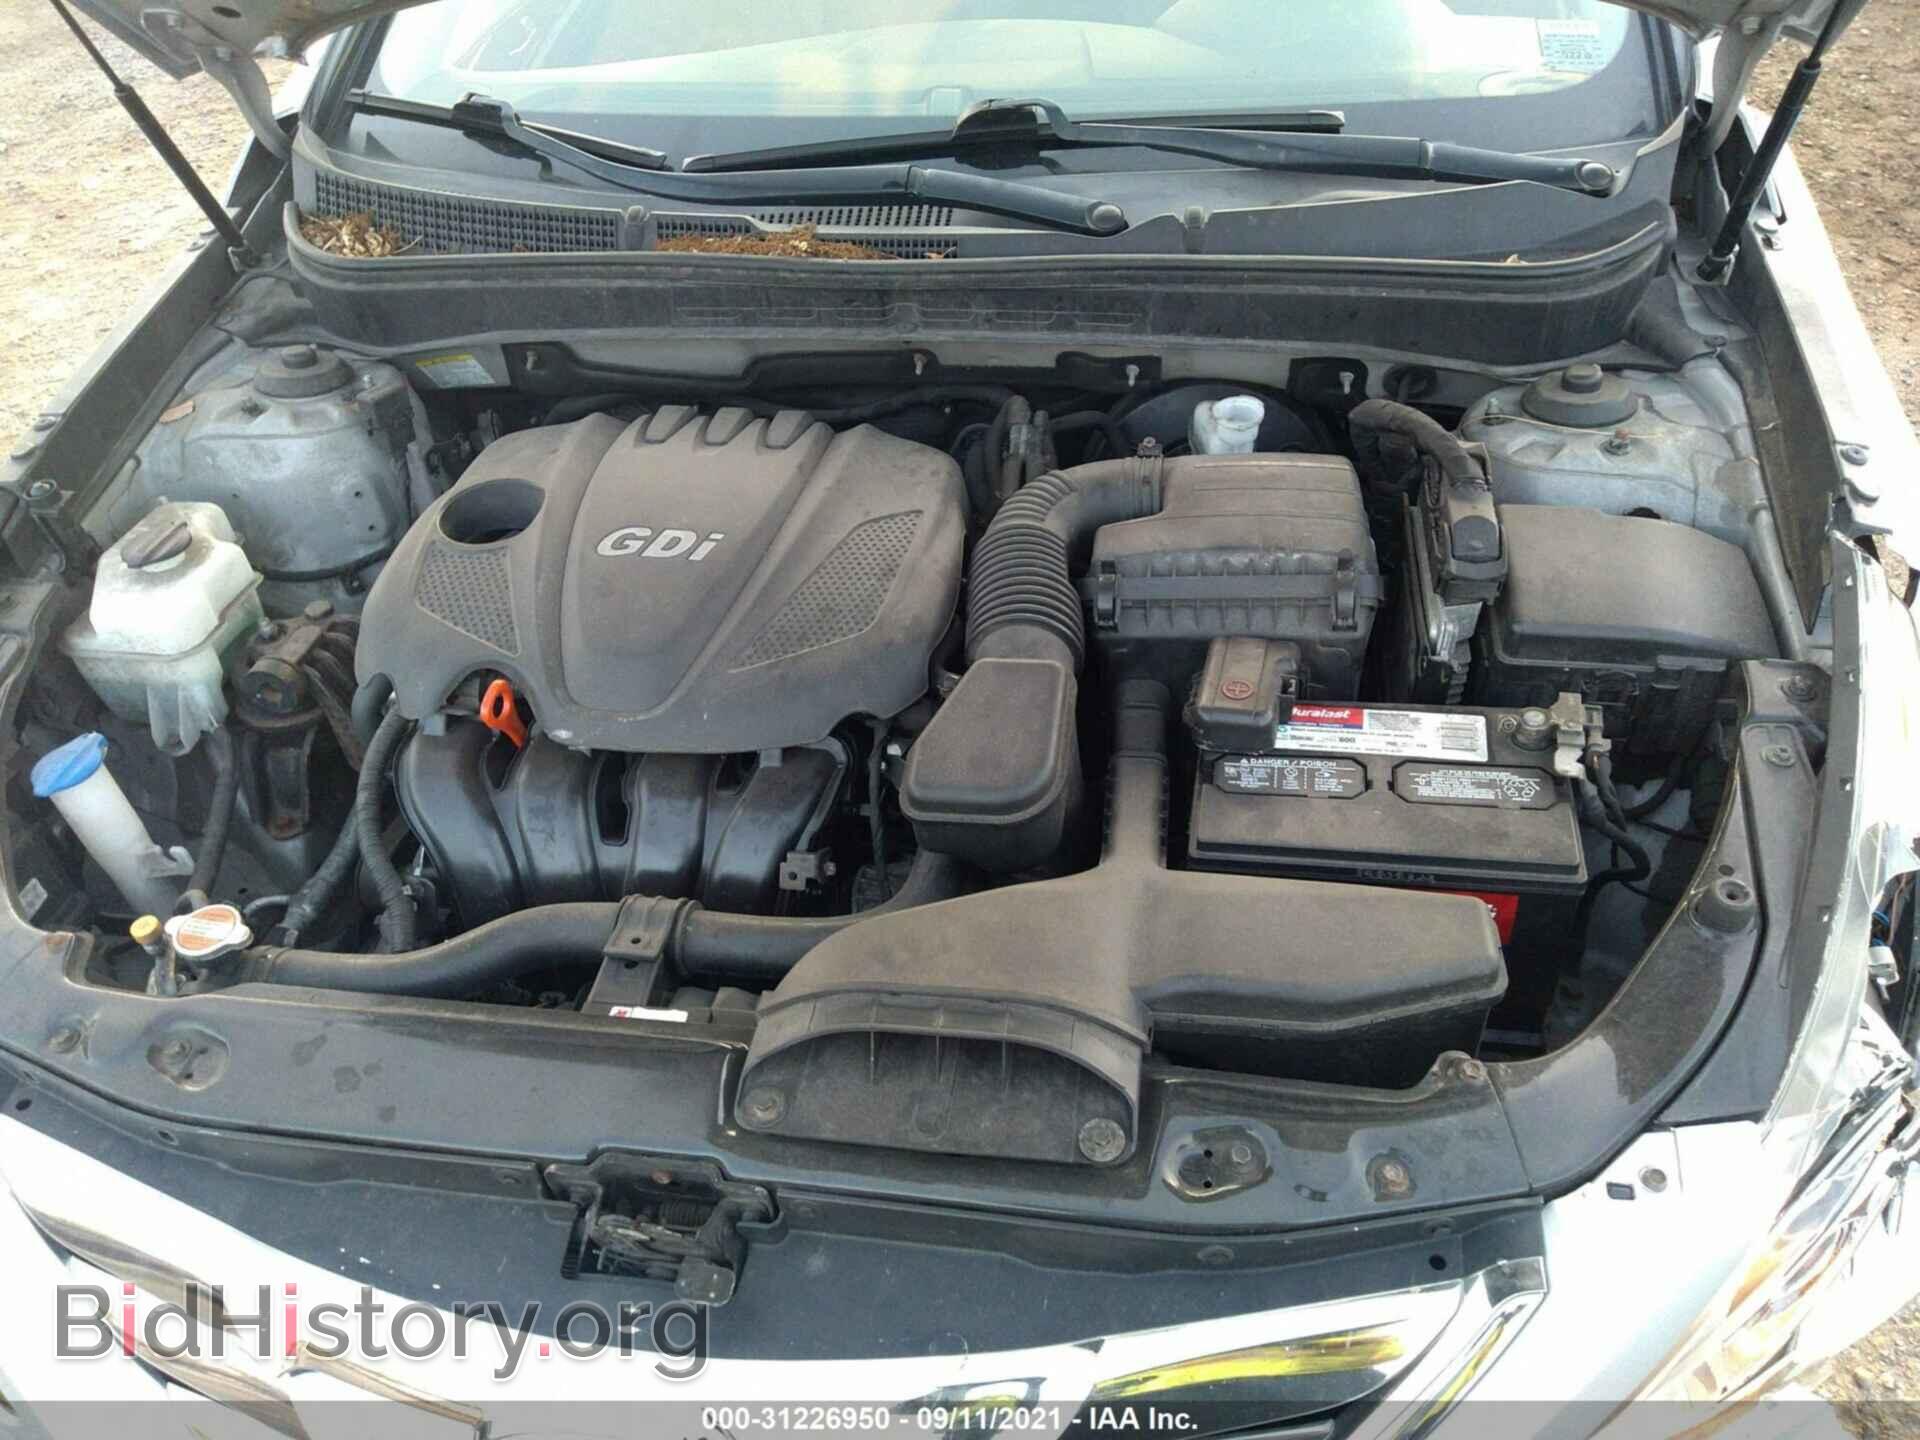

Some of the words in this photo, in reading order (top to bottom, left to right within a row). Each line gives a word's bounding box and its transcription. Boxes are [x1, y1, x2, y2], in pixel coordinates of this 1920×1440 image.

[596, 527, 725, 560] GDi
[1250, 758, 1290, 767] DANGER
[1300, 760, 1337, 768] POISON
